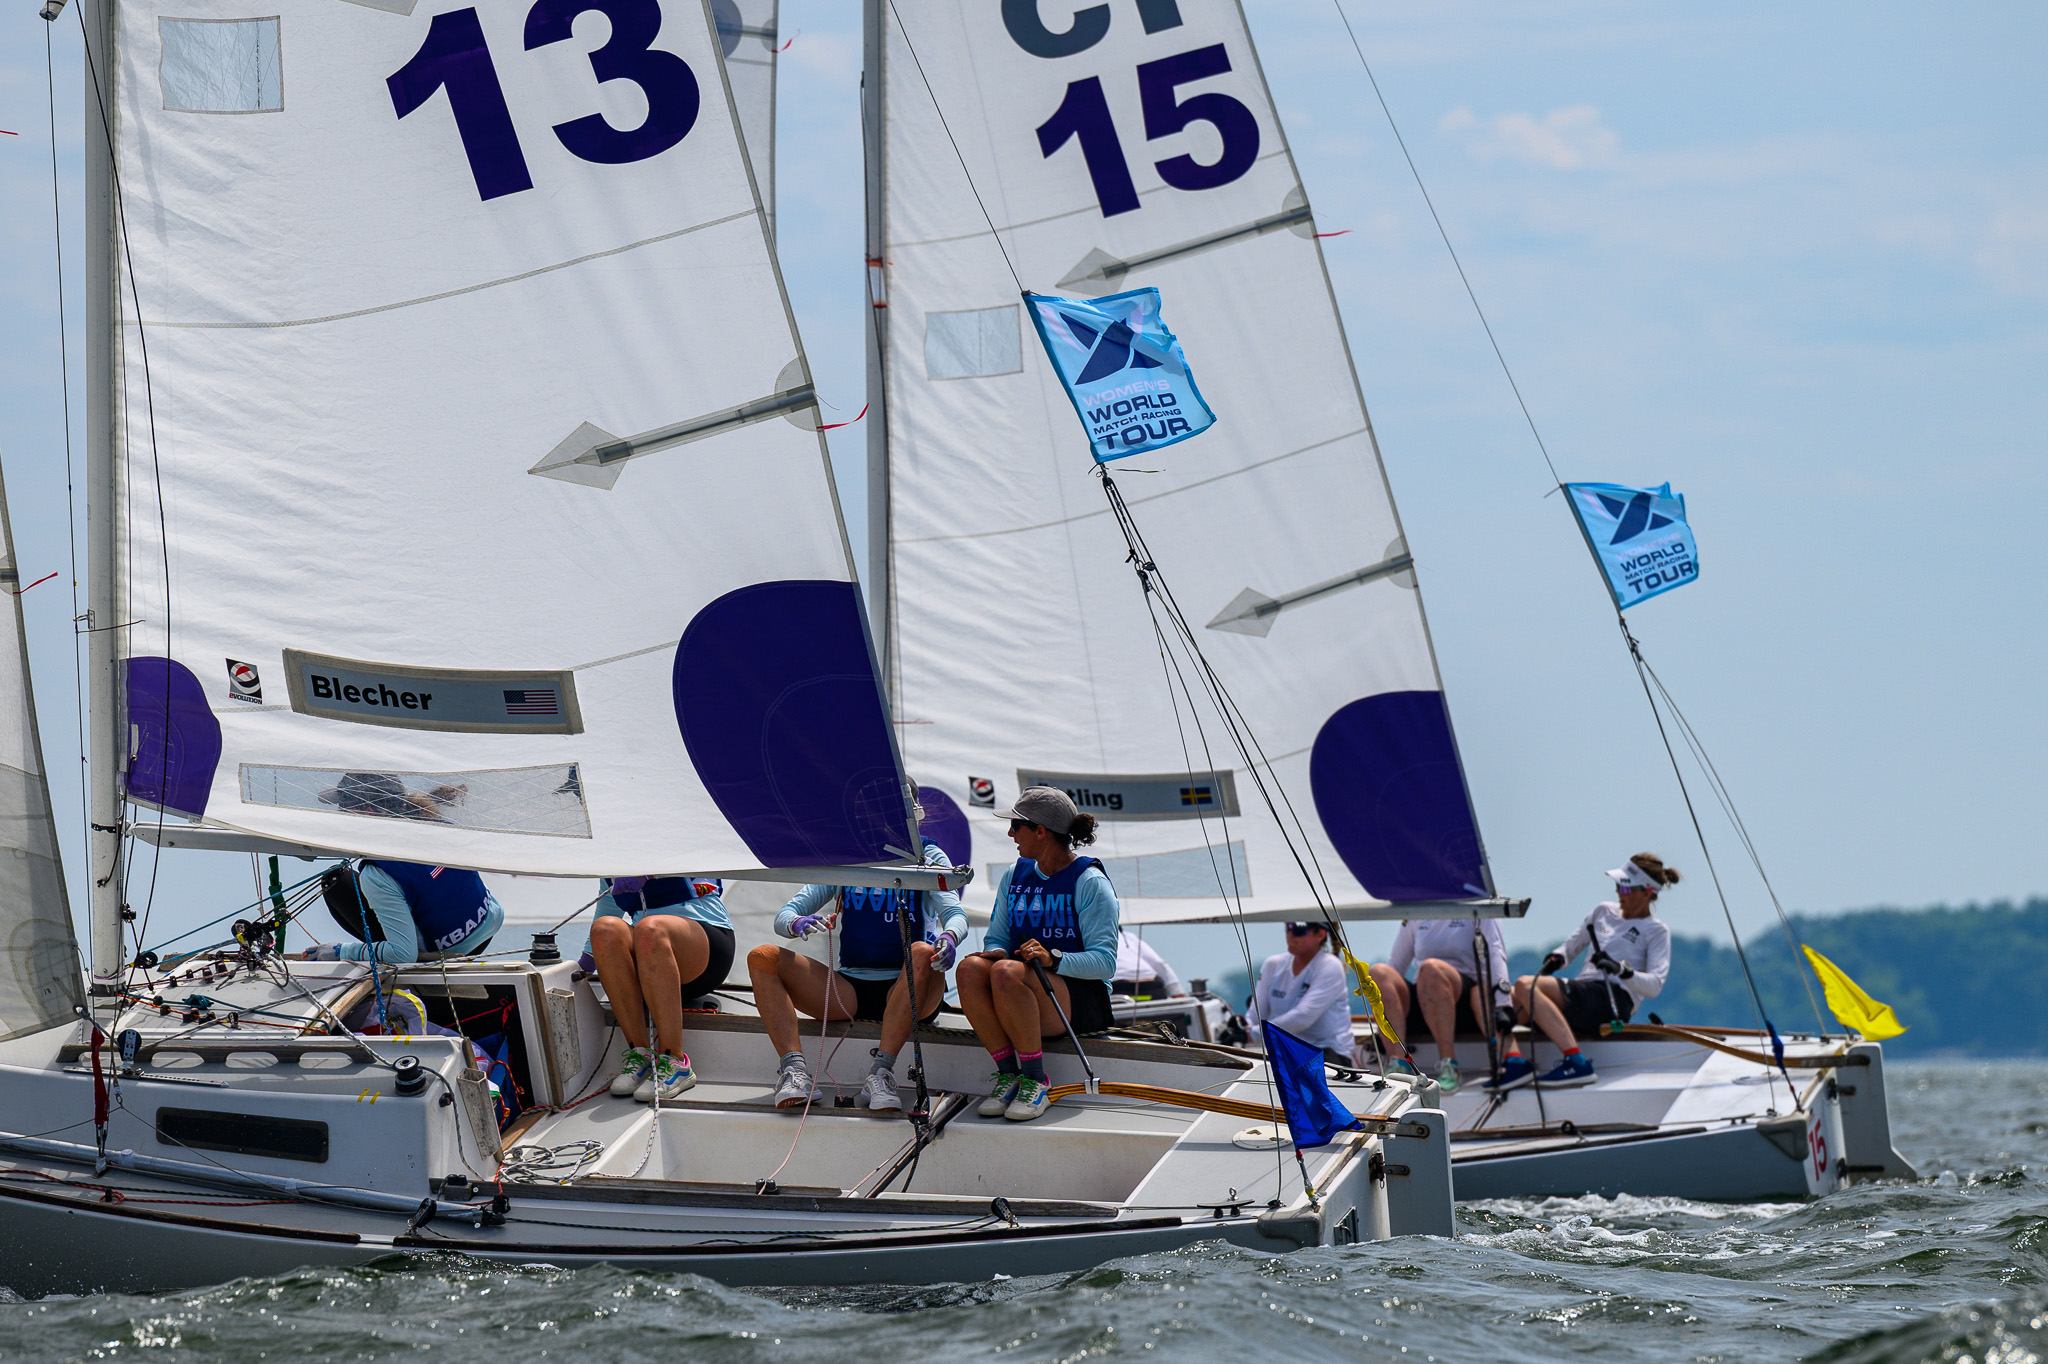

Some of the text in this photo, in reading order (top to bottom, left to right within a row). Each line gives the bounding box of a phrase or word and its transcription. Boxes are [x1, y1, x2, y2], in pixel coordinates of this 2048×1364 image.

[386, 0, 700, 202] 13
[1035, 42, 1260, 218] 15
[1082, 380, 1170, 407] WOMEN'S
[1087, 392, 1177, 424] WORLD
[1094, 408, 1182, 435] MATCH RACING
[1097, 417, 1193, 450] TOUR
[1620, 542, 1685, 572] WORLD
[1625, 553, 1690, 581] MATCH RACING
[1628, 561, 1694, 593] TOUR
[311, 674, 433, 710] Blecher
[1009, 885, 1044, 894] TEAM
[884, 911, 916, 922] UA
[1042, 927, 1077, 938] USA
[1808, 1118, 1827, 1182] 15
